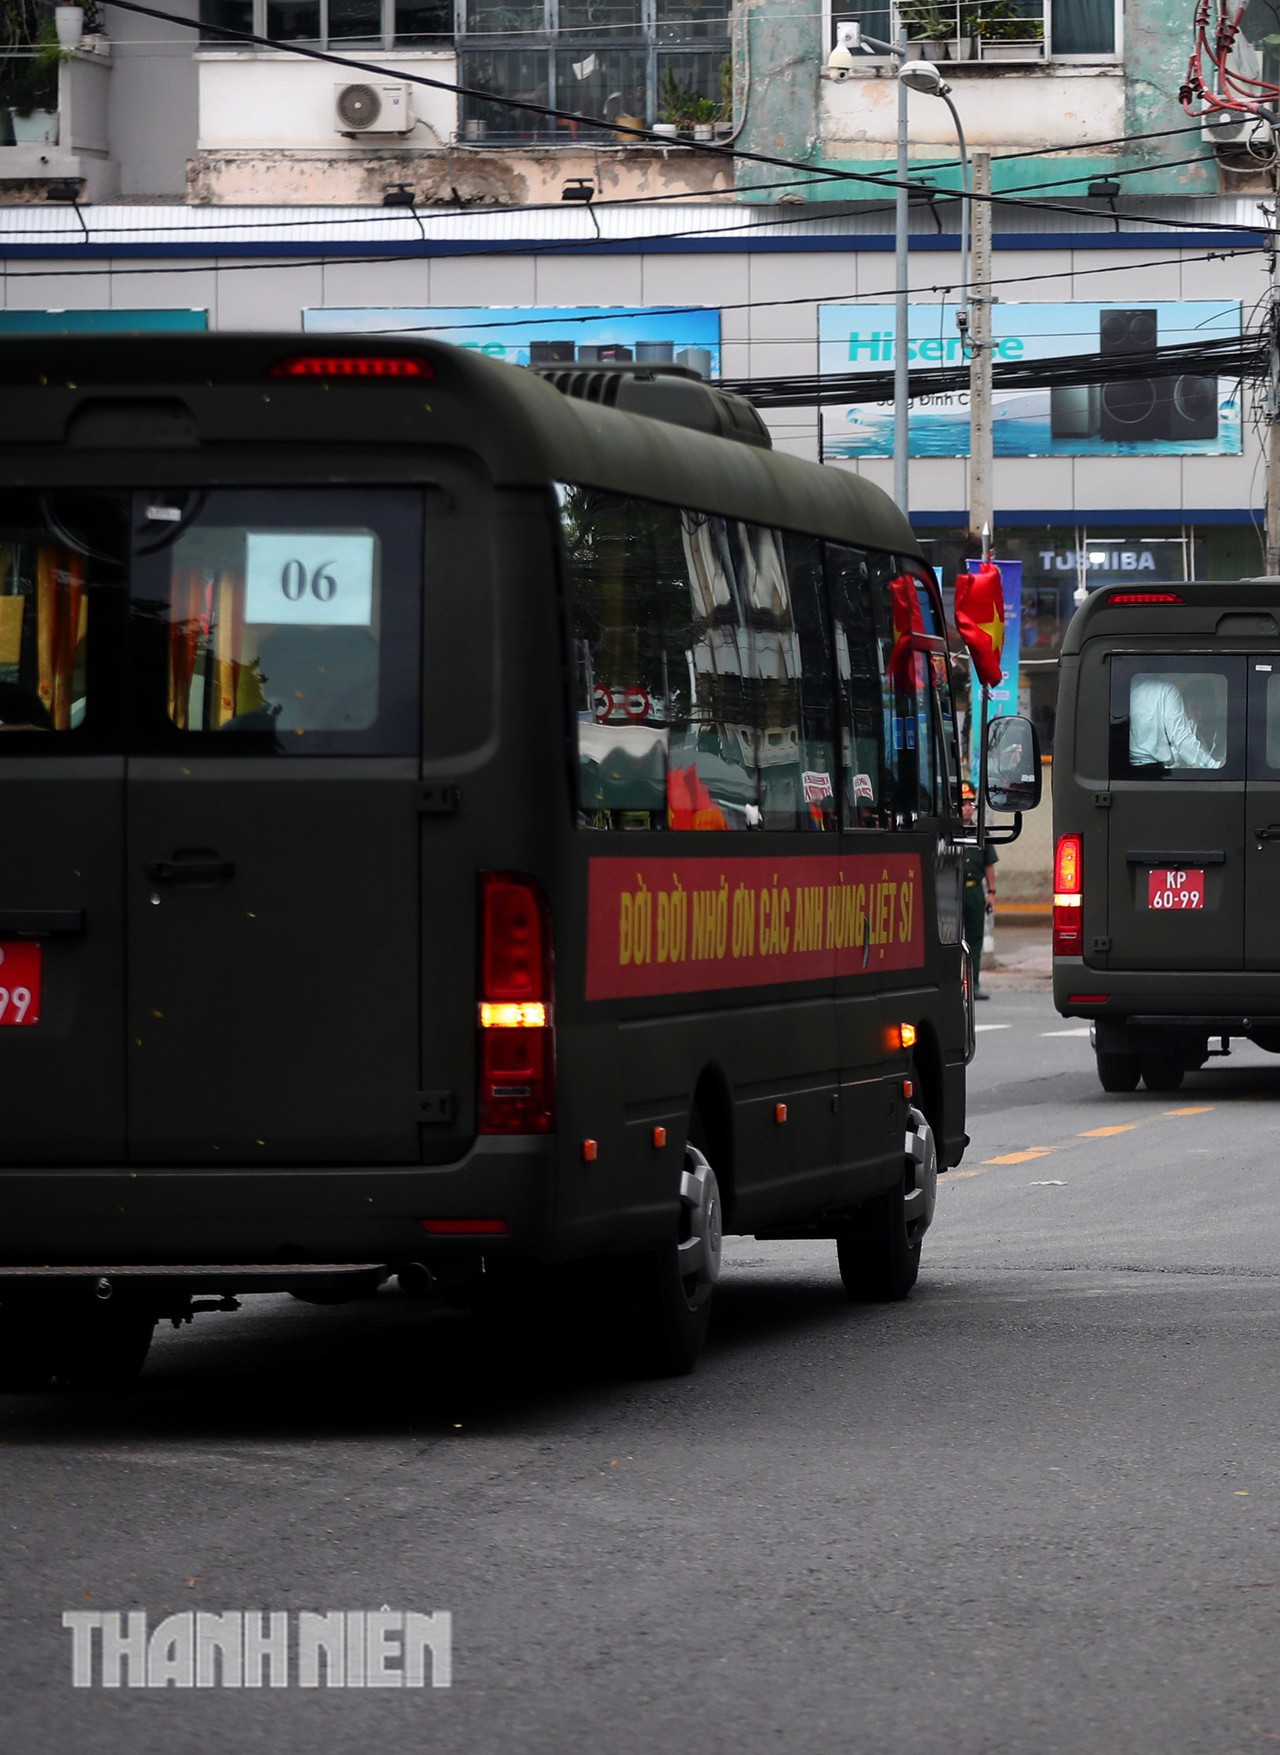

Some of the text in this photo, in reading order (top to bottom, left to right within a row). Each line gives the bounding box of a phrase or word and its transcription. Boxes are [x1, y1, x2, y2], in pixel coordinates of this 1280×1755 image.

[848, 331, 1025, 362] Hiene
[281, 559, 338, 602] 06
[1166, 871, 1187, 889] KP
[1153, 890, 1200, 908] 60-99
[619, 869, 915, 966] ĐỜI ĐỜI NHỚ ƠN CÁC ANH HÙNG LIỆT SĨ
